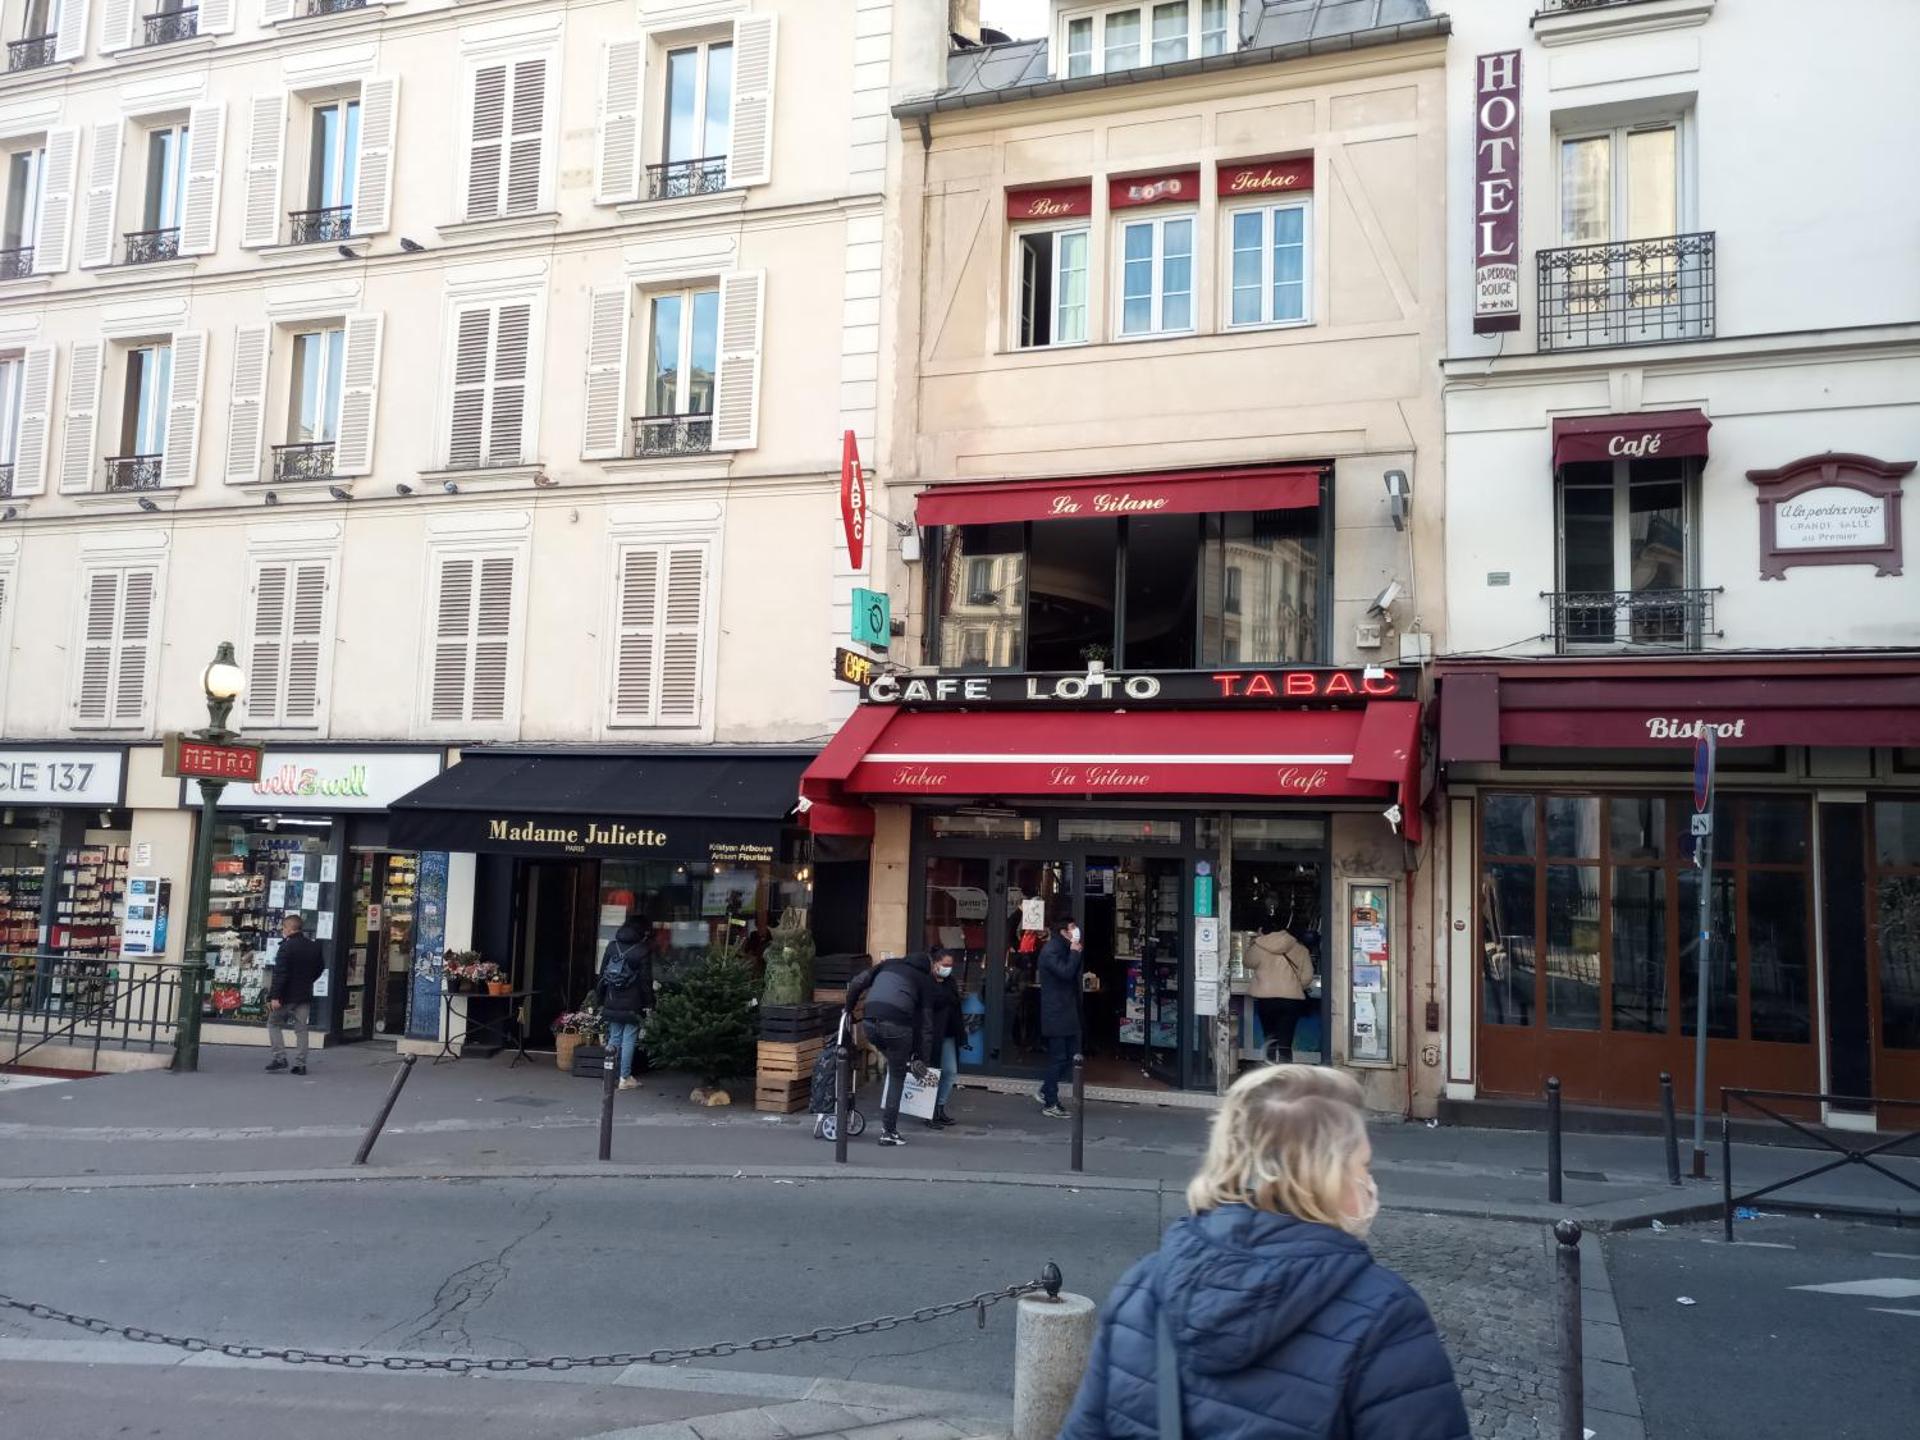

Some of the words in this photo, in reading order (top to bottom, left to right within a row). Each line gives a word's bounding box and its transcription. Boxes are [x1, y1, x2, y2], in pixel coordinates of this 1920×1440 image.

[1478, 51, 1517, 259] HOTEL
[1128, 178, 1182, 201] LOTO
[1231, 170, 1299, 191] Tabac
[1028, 198, 1074, 216] Bar
[1477, 269, 1487, 285] LA
[1481, 282, 1512, 296] ROUGE
[1608, 433, 1661, 457] Café
[850, 460, 862, 540] TABAC
[1048, 496, 1081, 516] La
[1093, 495, 1169, 513] Gitane
[868, 677, 992, 702] CAFE
[1026, 676, 1161, 700] LOTO
[1213, 673, 1398, 697] TABAC
[184, 748, 252, 773] METRO
[47, 762, 95, 791] 137
[893, 766, 948, 786] Tabac
[1047, 766, 1076, 786] La
[1085, 766, 1151, 786] Gitane
[1277, 767, 1328, 793] Café
[488, 819, 579, 843] Madame
[584, 823, 667, 846] Juliette
